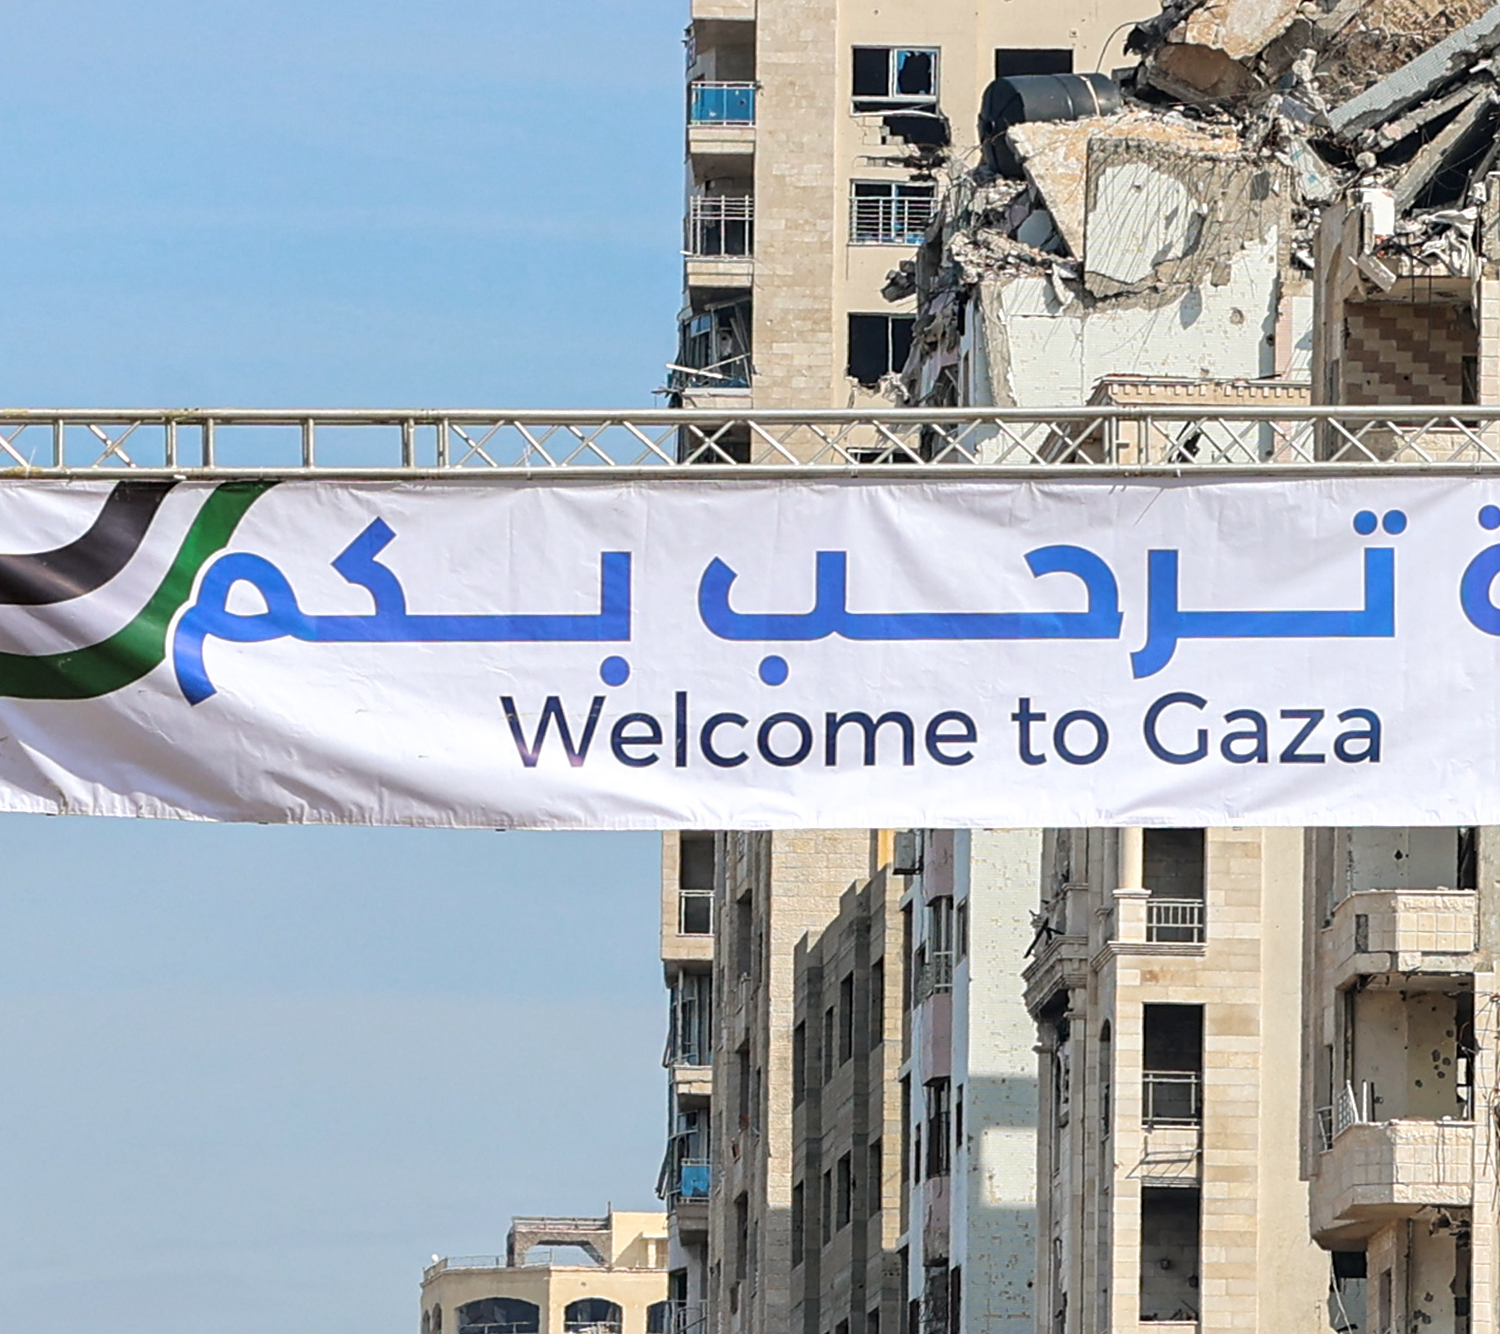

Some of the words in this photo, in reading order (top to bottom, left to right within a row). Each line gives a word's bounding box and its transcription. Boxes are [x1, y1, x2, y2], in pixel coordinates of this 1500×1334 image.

[172, 515, 632, 707] بكم
[698, 509, 1407, 687] ترحب
[500, 691, 978, 769] Welcome
[1011, 696, 1110, 766] to
[1142, 691, 1382, 767] Gaza
